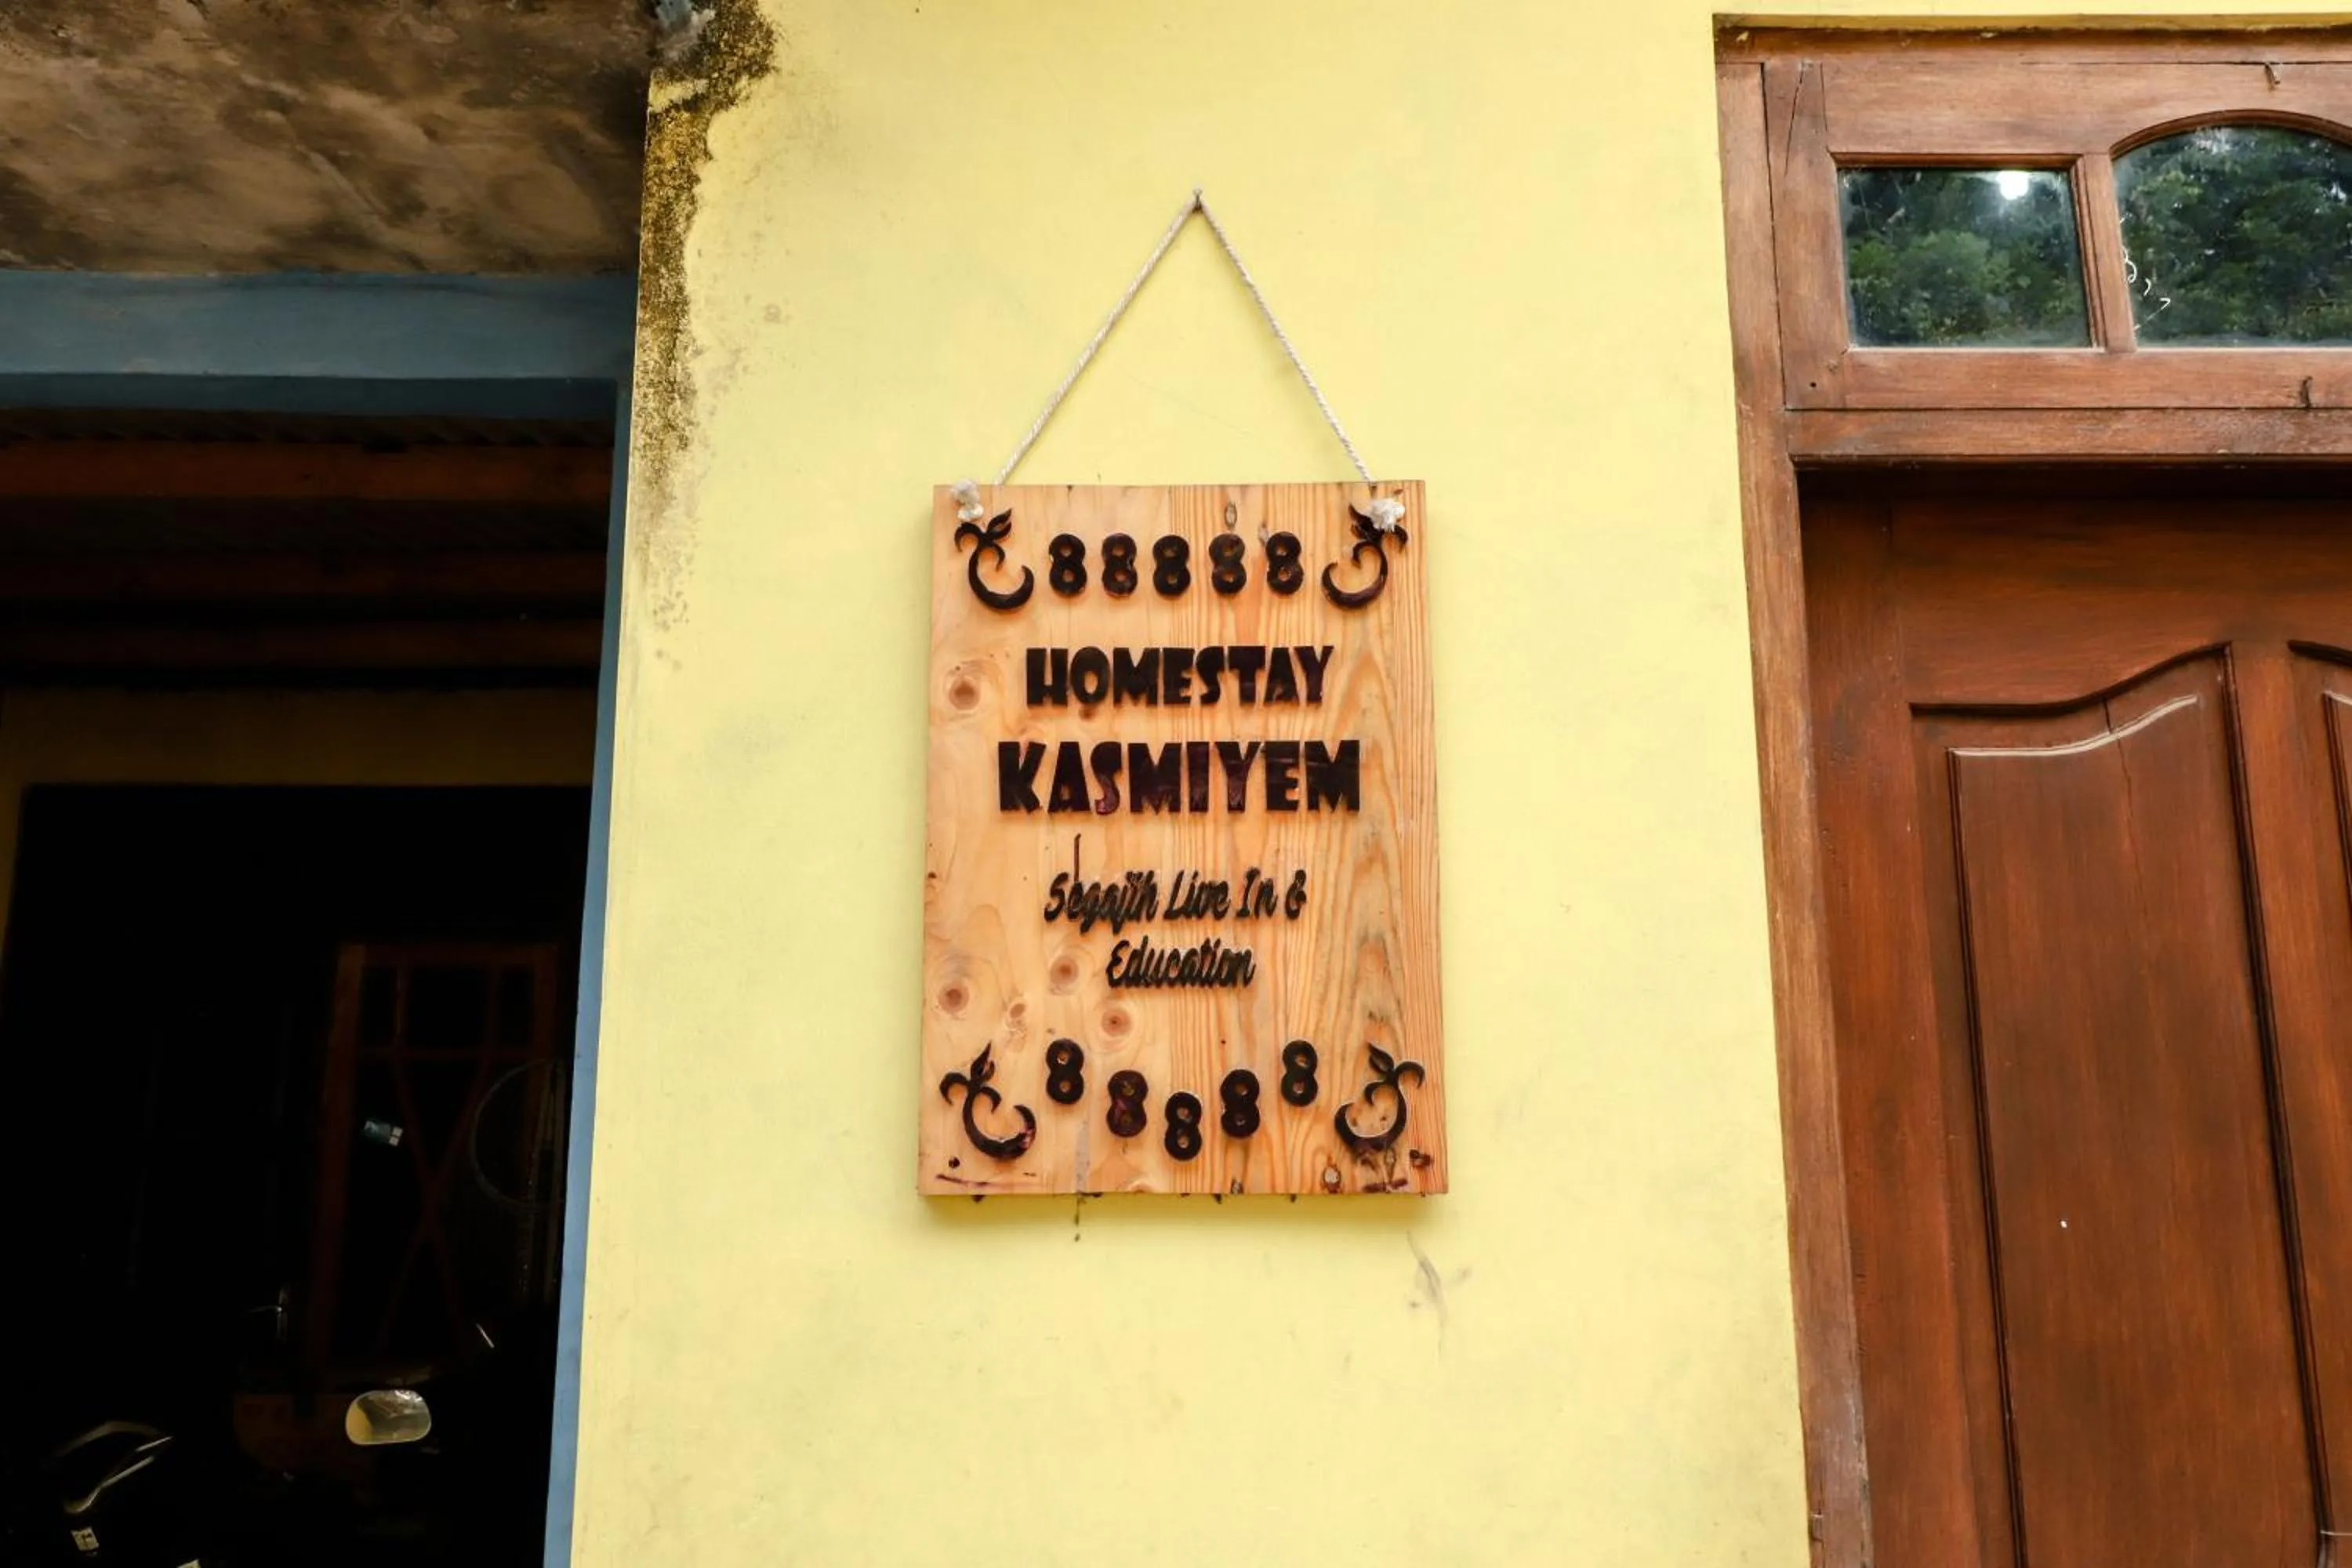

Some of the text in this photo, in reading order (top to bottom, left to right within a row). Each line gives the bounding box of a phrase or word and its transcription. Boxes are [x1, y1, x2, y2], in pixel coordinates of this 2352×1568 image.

[1026, 645, 1334, 706] HOMESTAY
[997, 740, 1361, 815] KASMIYEM
[1163, 869, 1232, 920] Live
[1236, 866, 1279, 920] In
[1284, 869, 1307, 920] &
[1105, 935, 1257, 989] Education
